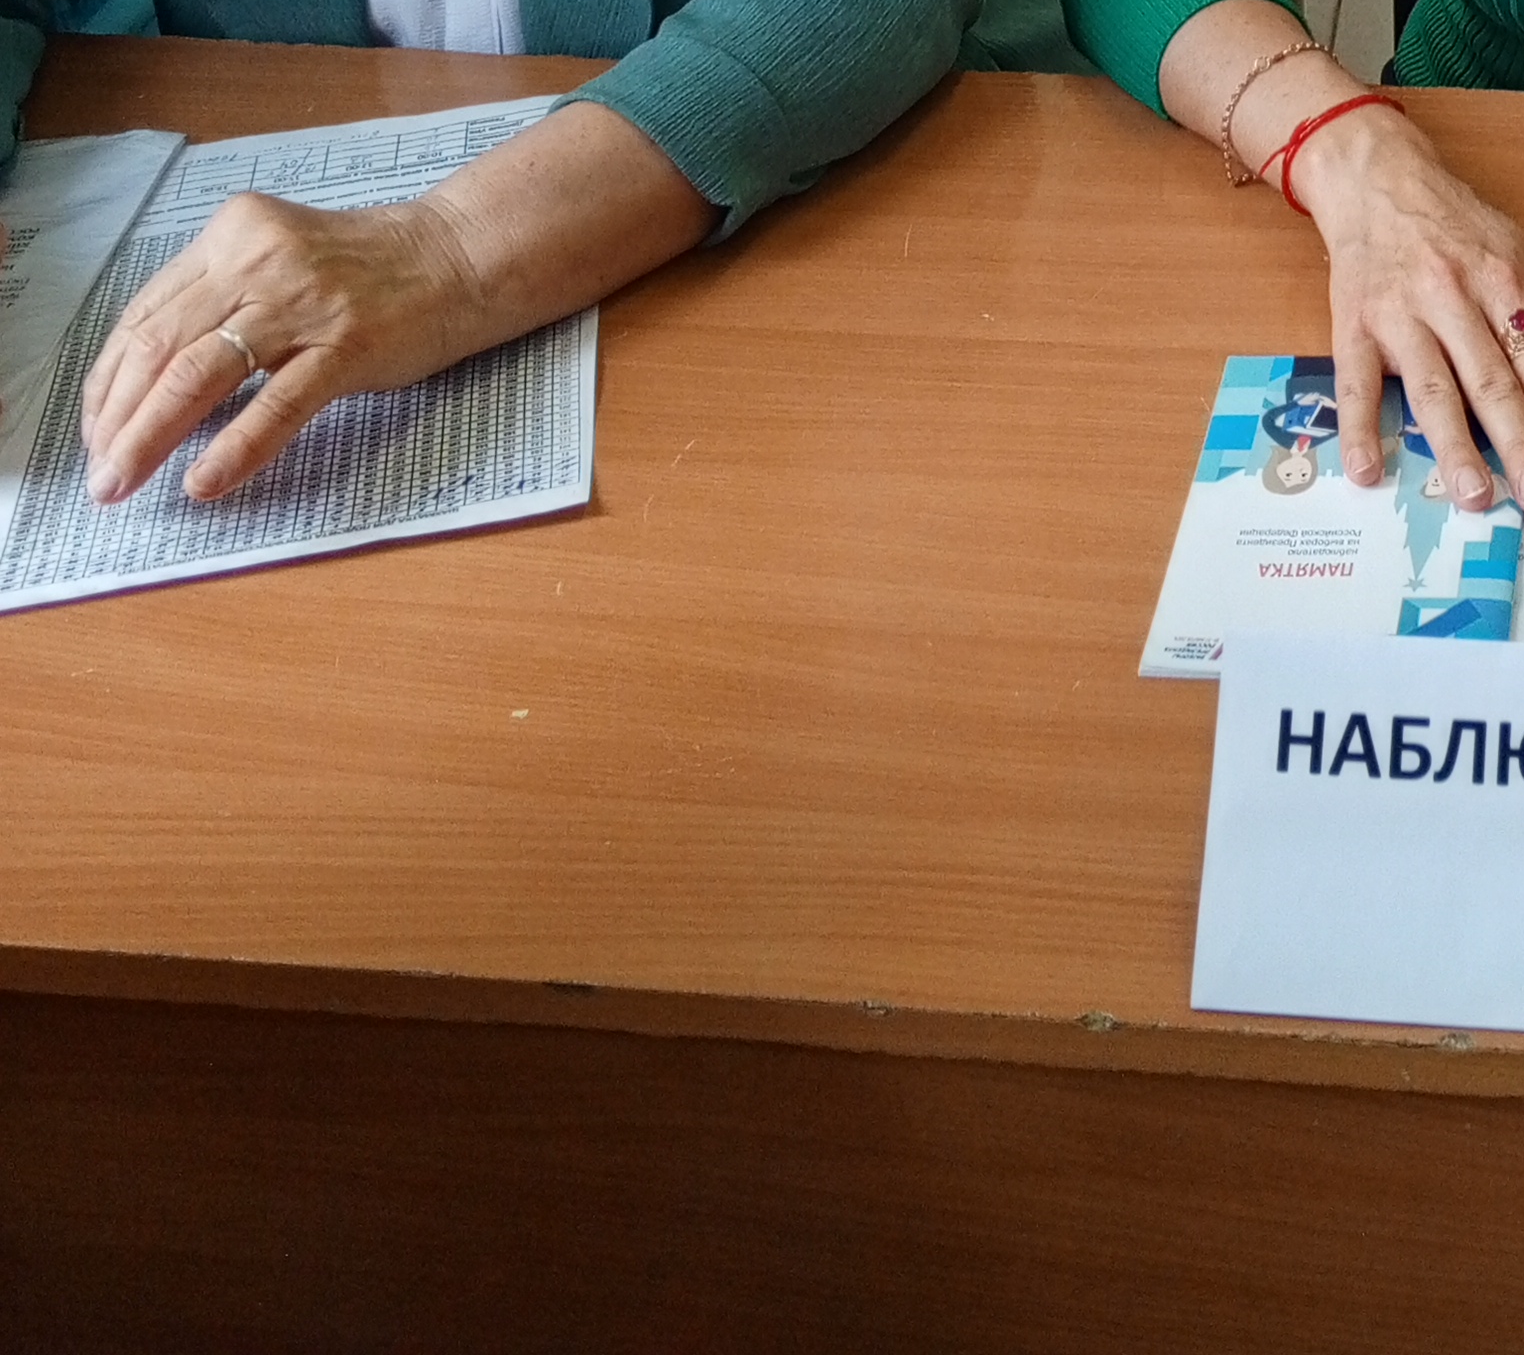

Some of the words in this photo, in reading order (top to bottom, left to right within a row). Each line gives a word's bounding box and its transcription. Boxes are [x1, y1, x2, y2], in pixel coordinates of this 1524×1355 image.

[1238, 527, 1299, 538] Федерации
[1301, 529, 1362, 538] Российской
[1236, 537, 1298, 548] Президента
[1300, 537, 1345, 547] выборах
[1347, 538, 1361, 546] на
[1287, 548, 1359, 557] наблюдателю
[1258, 562, 1355, 578] ПАМЯТКА
